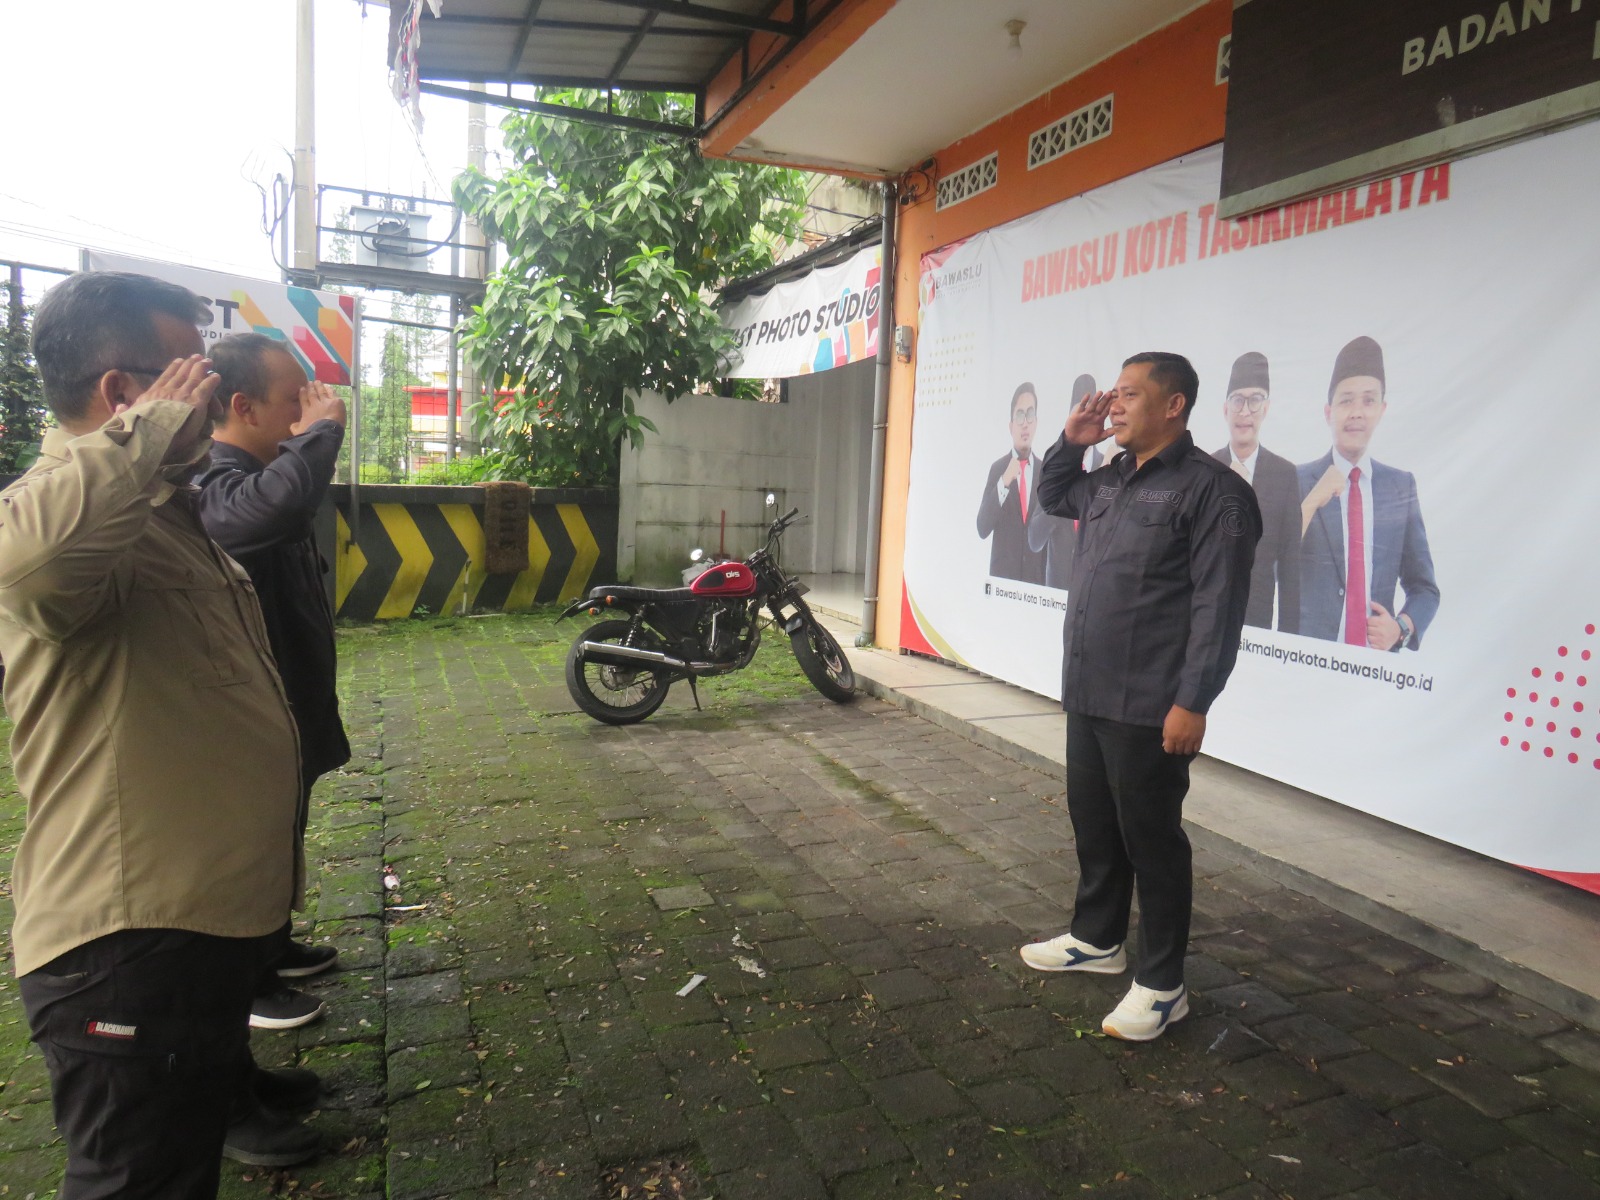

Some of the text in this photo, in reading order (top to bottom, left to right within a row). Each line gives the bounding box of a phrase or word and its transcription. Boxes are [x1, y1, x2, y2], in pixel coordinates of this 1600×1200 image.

[1402, 0, 1552, 76] BADAN
[935, 262, 983, 290] BAWASLU
[1021, 231, 1119, 303] BAWASLU
[1123, 210, 1188, 278] KOTA
[755, 309, 811, 346] PHOTO
[813, 284, 881, 333] STUDIO
[995, 587, 1023, 601] Bawaslu
[1023, 592, 1038, 604] Kota
